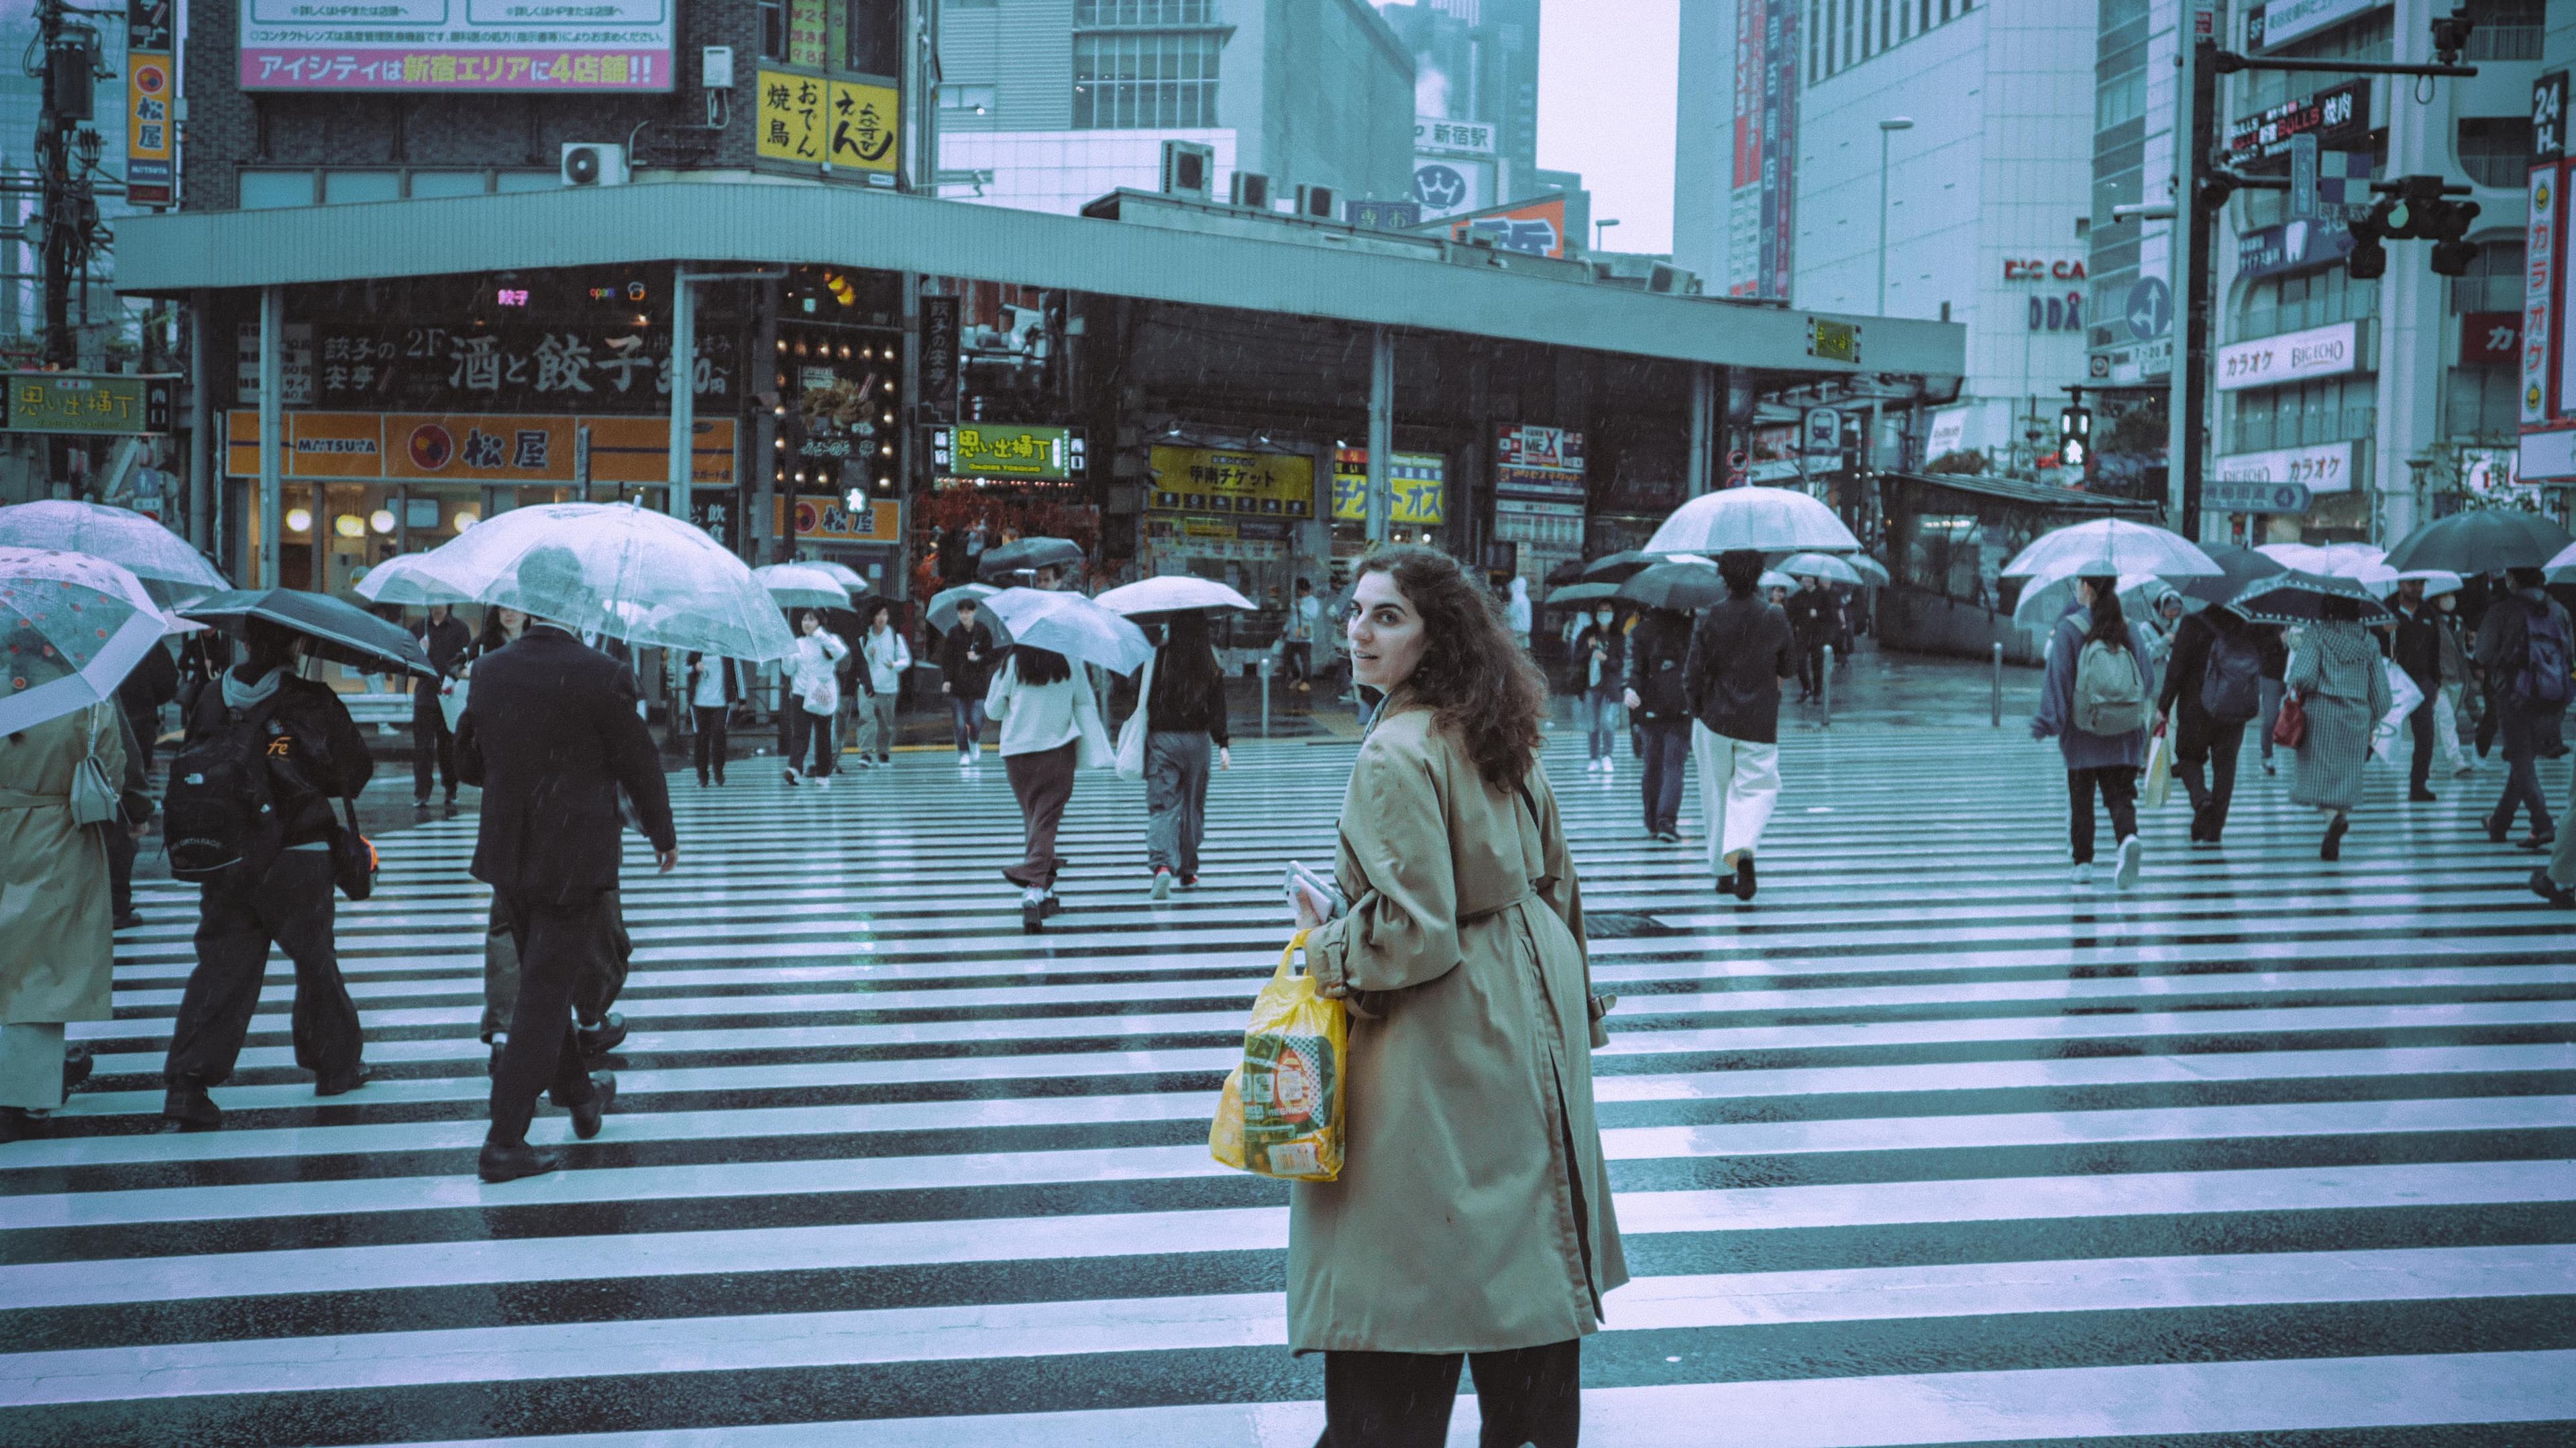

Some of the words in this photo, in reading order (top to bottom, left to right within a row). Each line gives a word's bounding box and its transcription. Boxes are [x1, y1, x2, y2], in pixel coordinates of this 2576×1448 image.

[136, 97, 165, 150] 松屋
[767, 83, 791, 148] 焼鳥
[796, 80, 818, 158] おでん
[2277, 107, 2320, 137] BULLS
[1434, 124, 1487, 147] 新宿駅
[498, 290, 529, 307] 餃子
[2526, 223, 2549, 371] カラオケ
[449, 333, 654, 393] 酒と餃子
[2226, 349, 2273, 377] カラオケ
[298, 439, 377, 453] MATSUYA
[461, 427, 549, 469] 松屋
[958, 429, 1051, 461] 思い出横丁
[2290, 455, 2341, 482] カラオケ
[821, 504, 875, 535] 松屋
